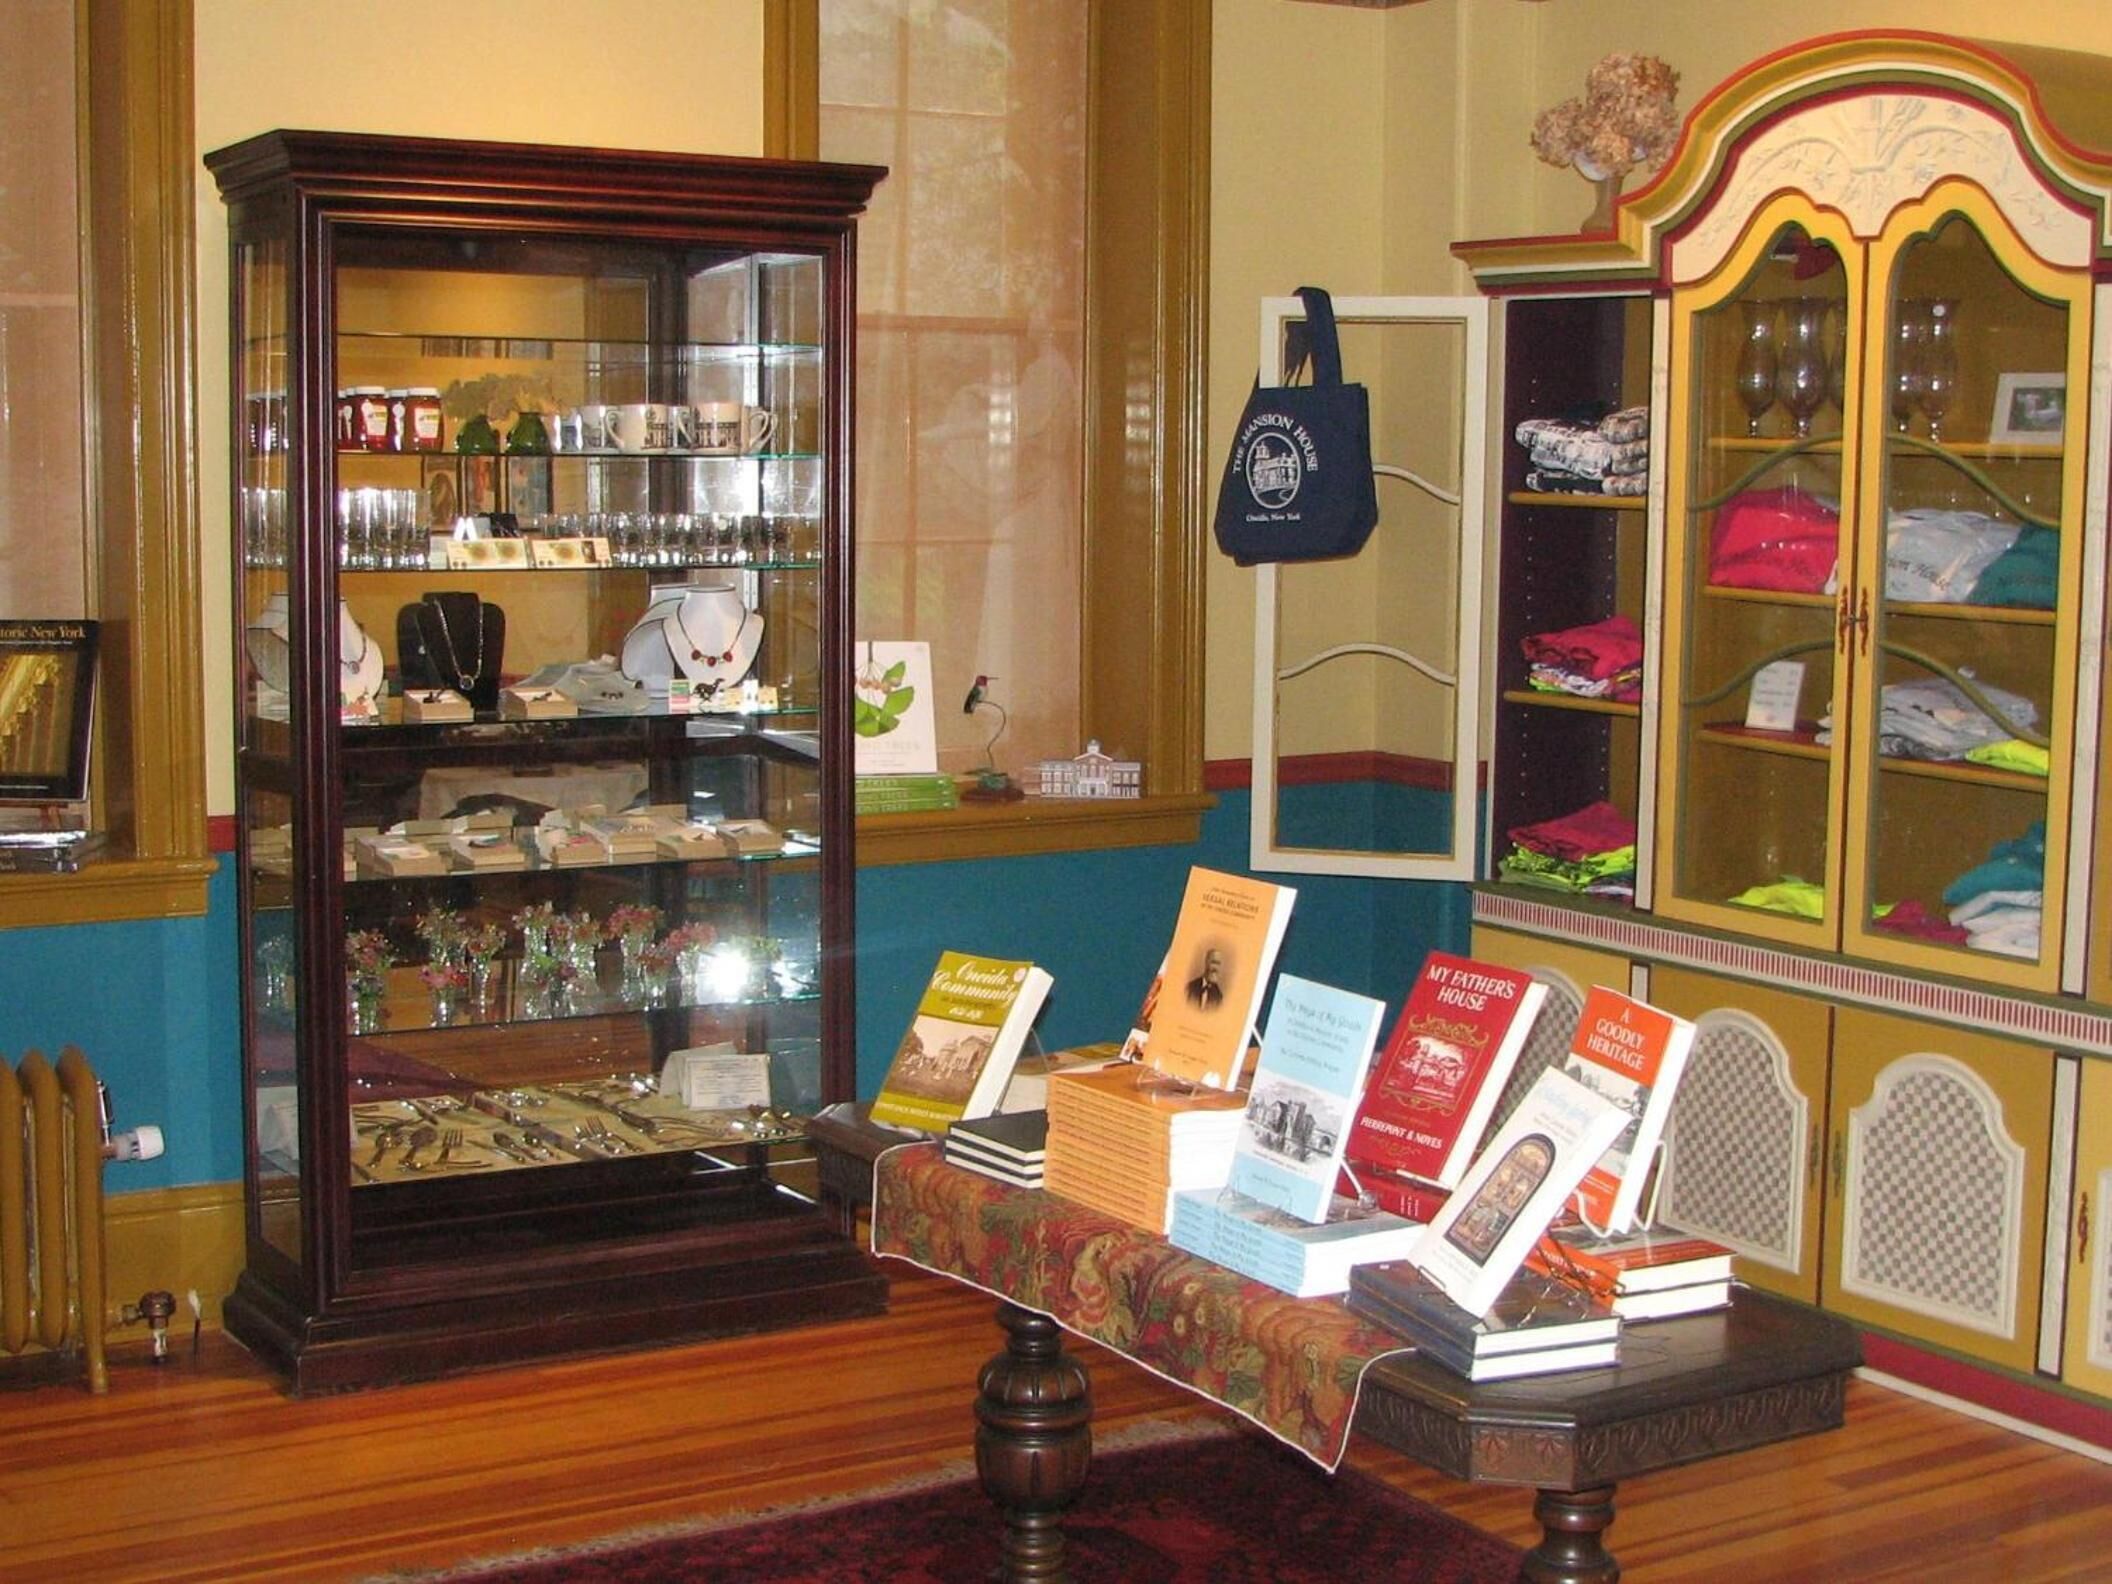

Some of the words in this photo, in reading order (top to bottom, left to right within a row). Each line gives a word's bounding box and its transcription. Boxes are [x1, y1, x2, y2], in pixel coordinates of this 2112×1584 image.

[1232, 446, 1245, 474] THE
[1241, 413, 1294, 444] MANSION
[1293, 425, 1319, 473] HOUSE
[32, 625, 58, 640] New
[59, 625, 87, 639] York
[956, 960, 1009, 986] Oneida
[1427, 964, 1452, 984] MY
[1450, 969, 1517, 1000] FATHER'S
[931, 970, 1018, 1009] Community
[1437, 985, 1488, 1012] HOUSE
[1620, 1007, 1631, 1025] A
[1596, 1018, 1646, 1050] GOODLY
[1587, 1033, 1646, 1072] HERITAGE
